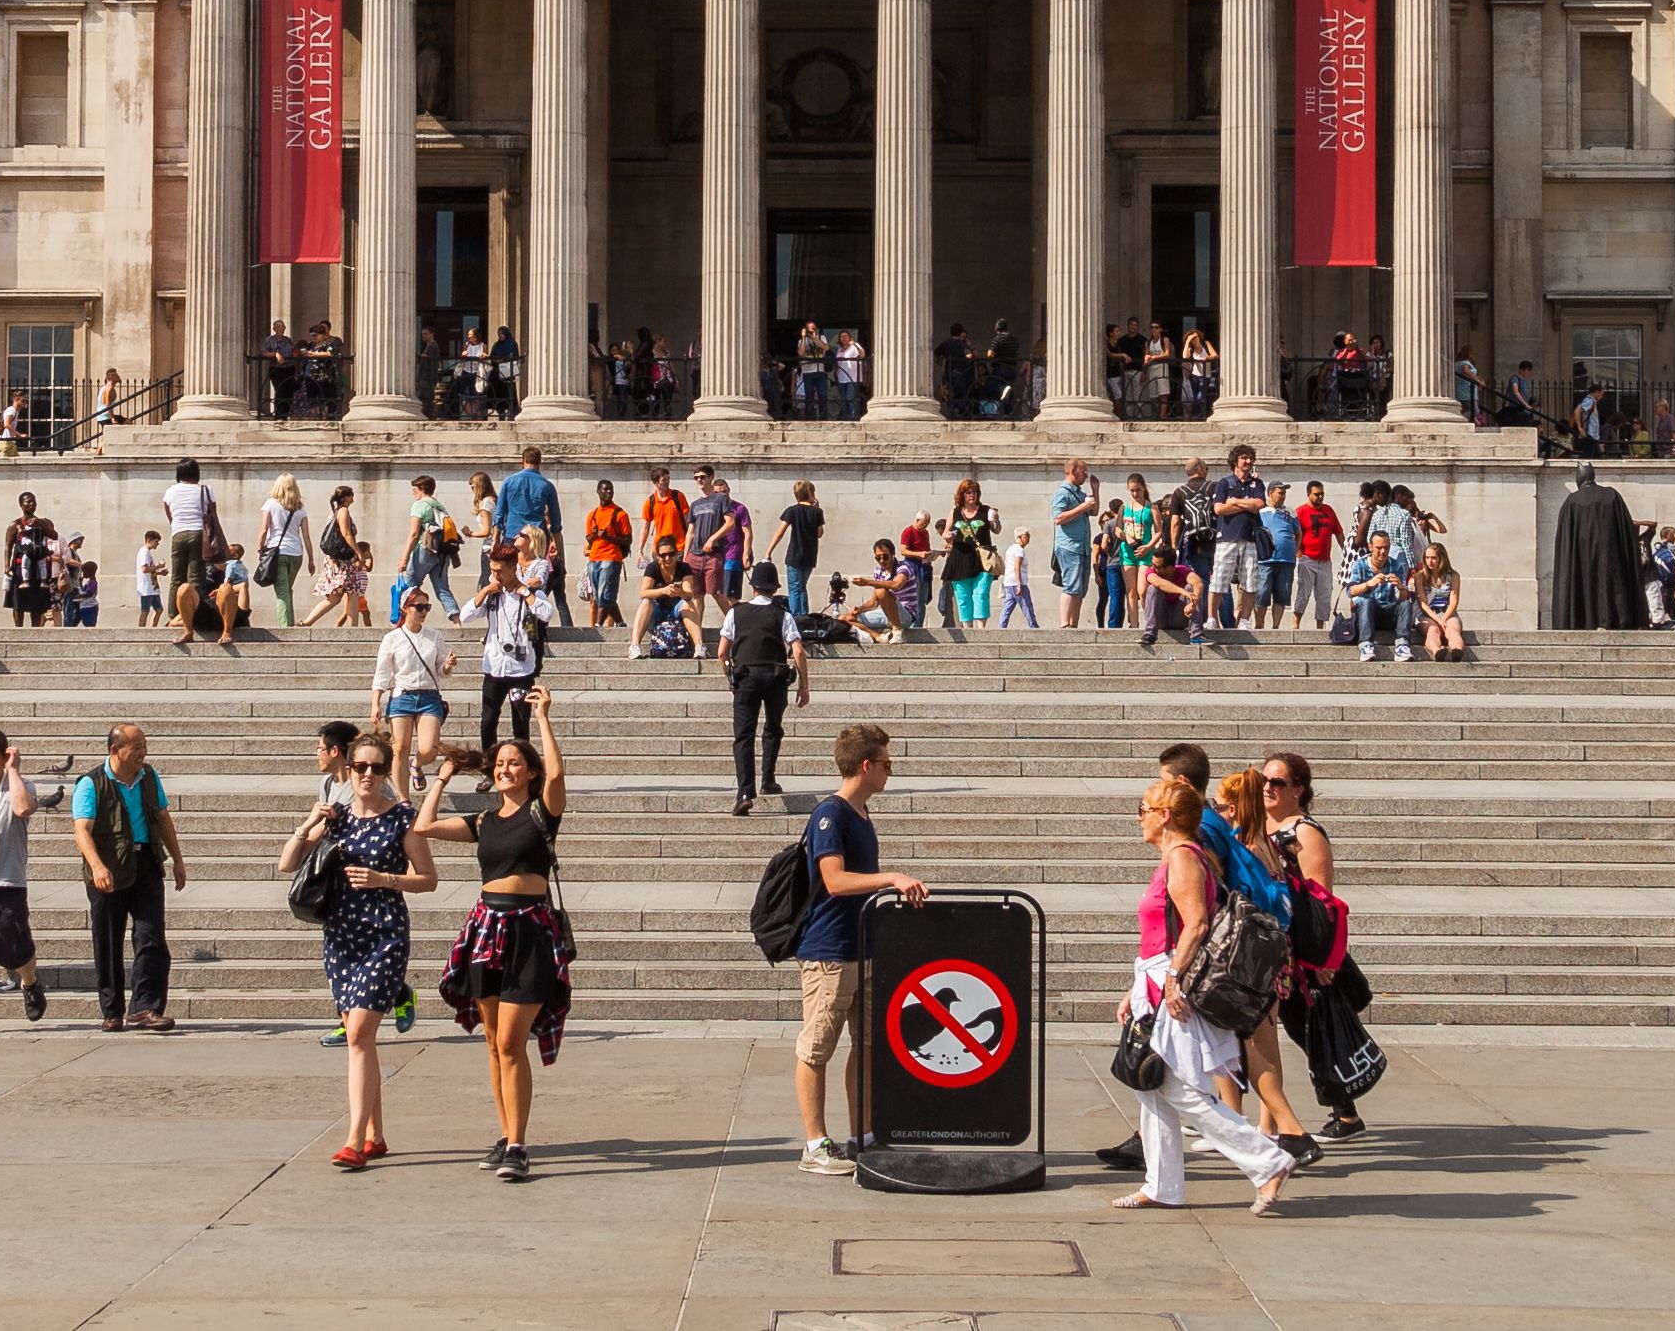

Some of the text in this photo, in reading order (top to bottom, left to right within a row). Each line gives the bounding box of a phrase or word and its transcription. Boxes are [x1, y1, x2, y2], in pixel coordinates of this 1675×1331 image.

[272, 85, 283, 113] THE
[286, 7, 306, 150] NATIONAL
[309, 8, 333, 151] GALLERY
[1305, 86, 1316, 114] THE
[1319, 8, 1339, 151] NATIONAL
[1342, 10, 1366, 152] GALLERY
[890, 1130, 1011, 1139] GREATERLONDONAUTHORITY
